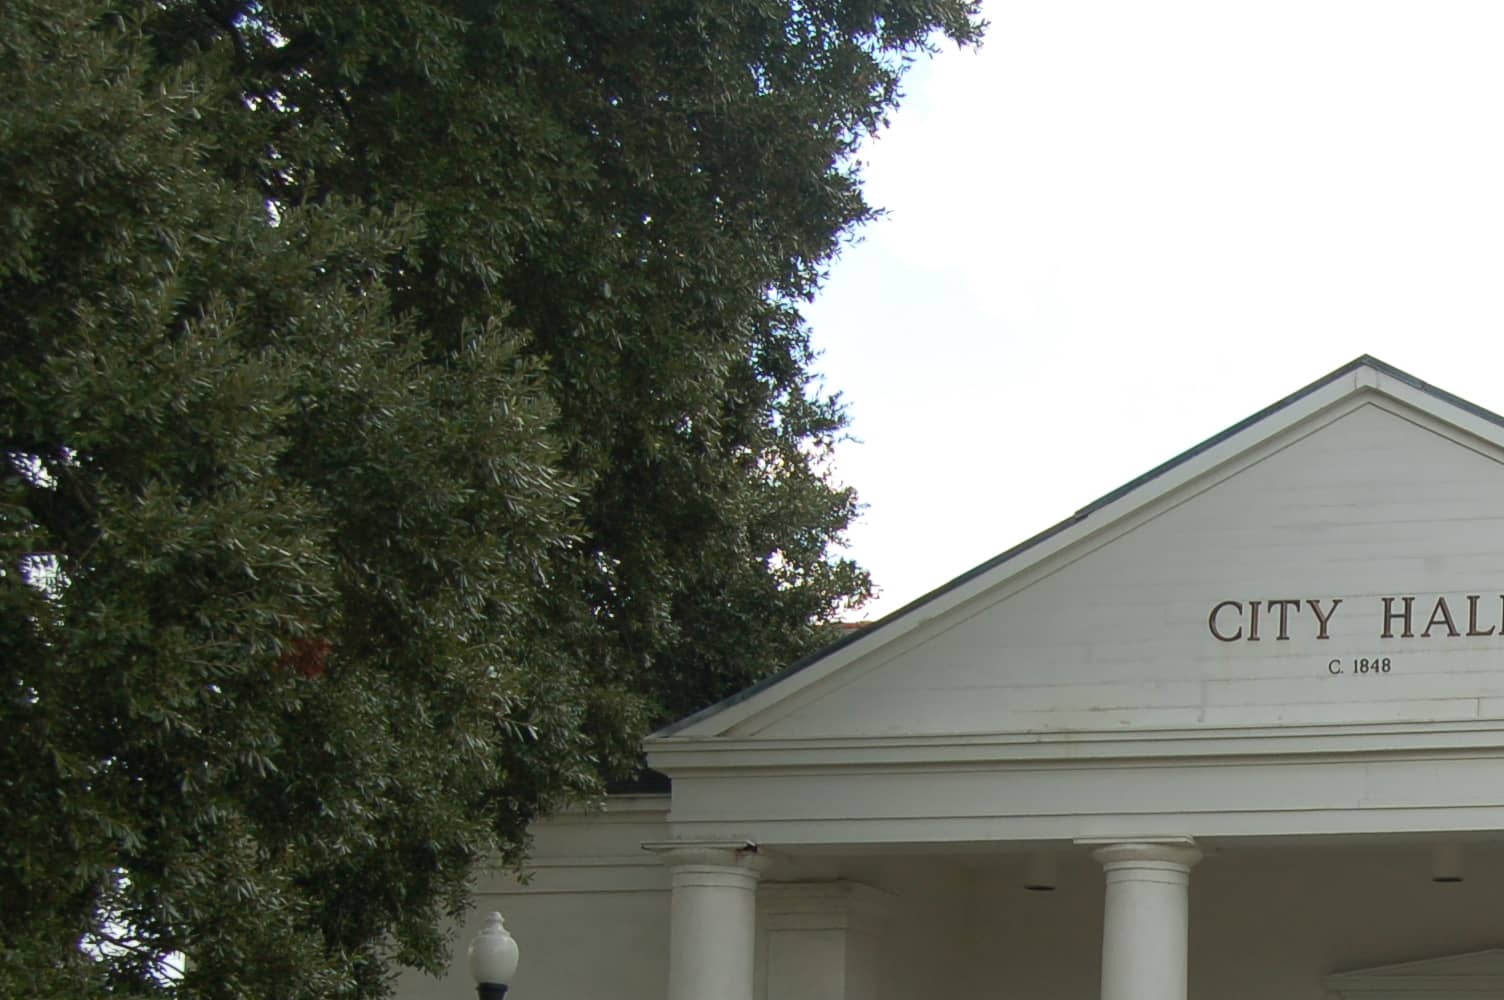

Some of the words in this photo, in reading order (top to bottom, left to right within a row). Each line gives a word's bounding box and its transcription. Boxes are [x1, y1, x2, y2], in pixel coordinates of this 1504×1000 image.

[1208, 599, 1343, 642] CITY
[1328, 658, 1344, 675] C.
[1353, 657, 1392, 674] 1848
